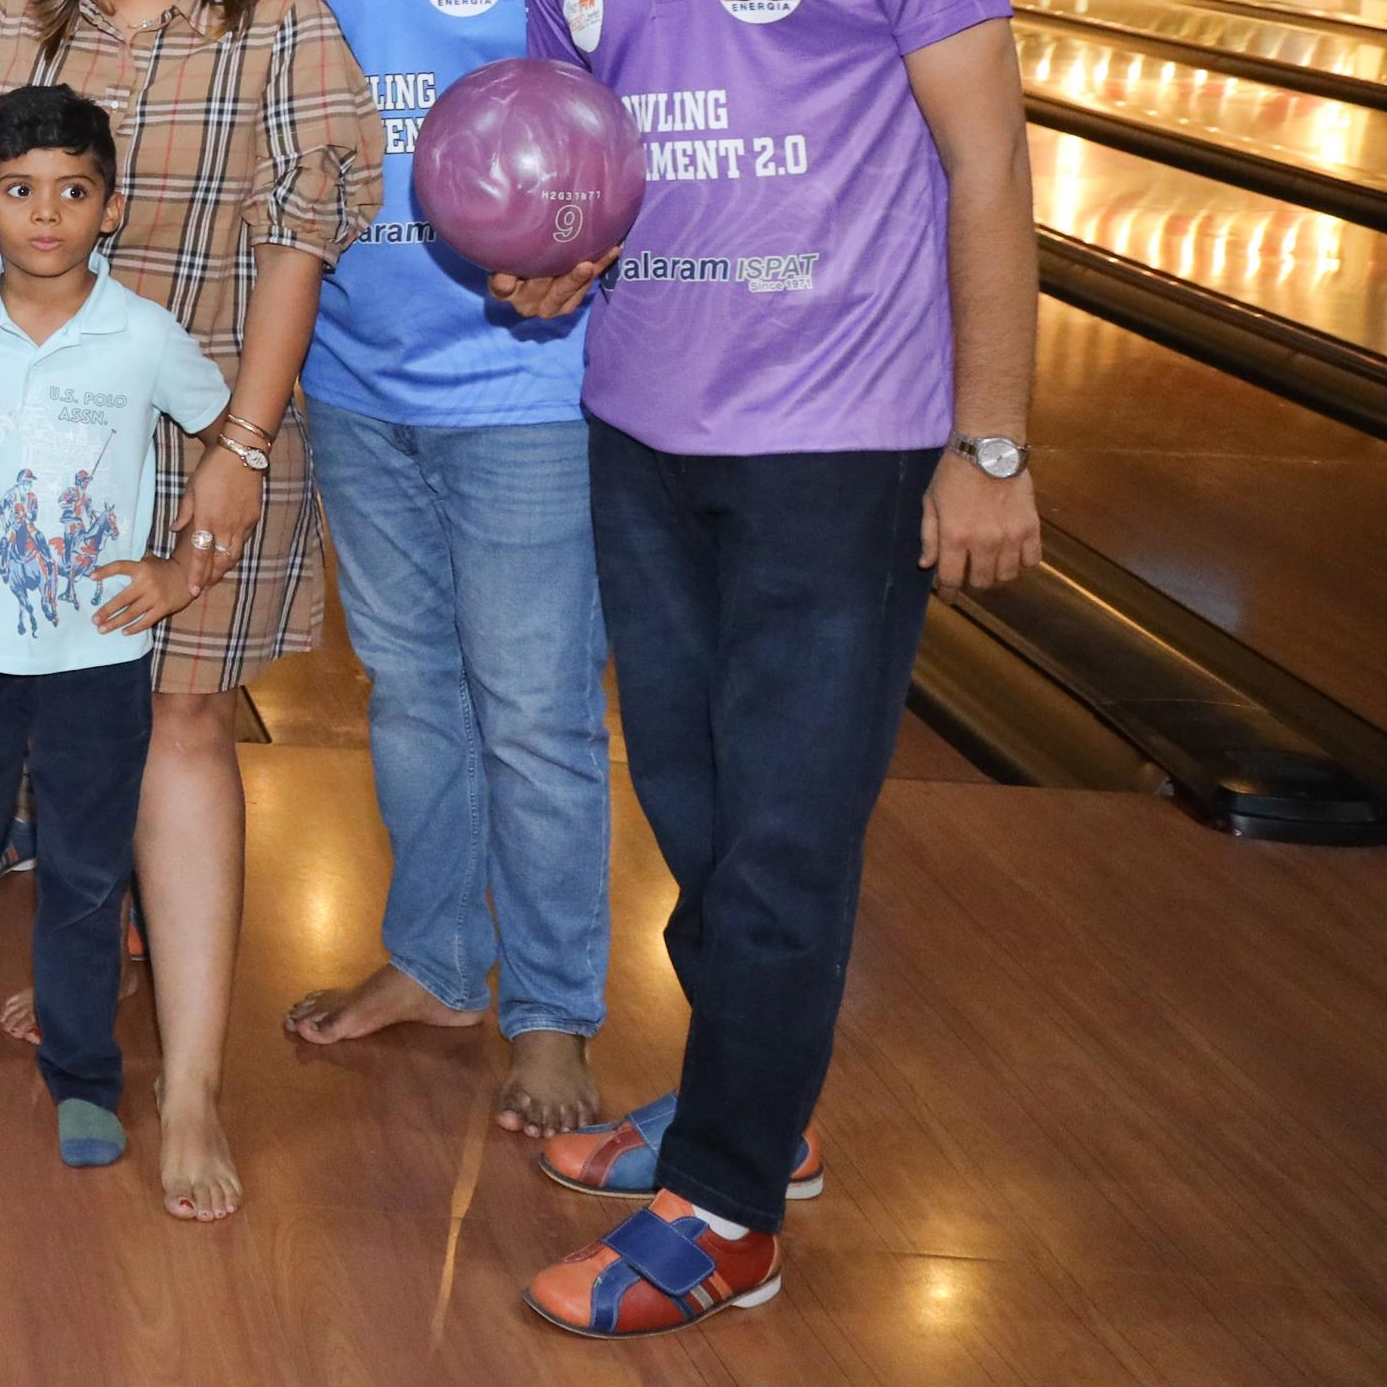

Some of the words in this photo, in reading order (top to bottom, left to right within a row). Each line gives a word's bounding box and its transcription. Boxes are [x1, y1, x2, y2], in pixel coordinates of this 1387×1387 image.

[731, 2, 790, 12] ENERGIA
[753, 134, 809, 178] 2.0
[553, 204, 583, 243] 9
[736, 253, 819, 282] ISPAT
[749, 278, 783, 292] Since
[785, 276, 814, 290] 1971
[49, 385, 78, 404] U.S.
[84, 391, 128, 409] POLO
[58, 406, 108, 426] ASSN.
